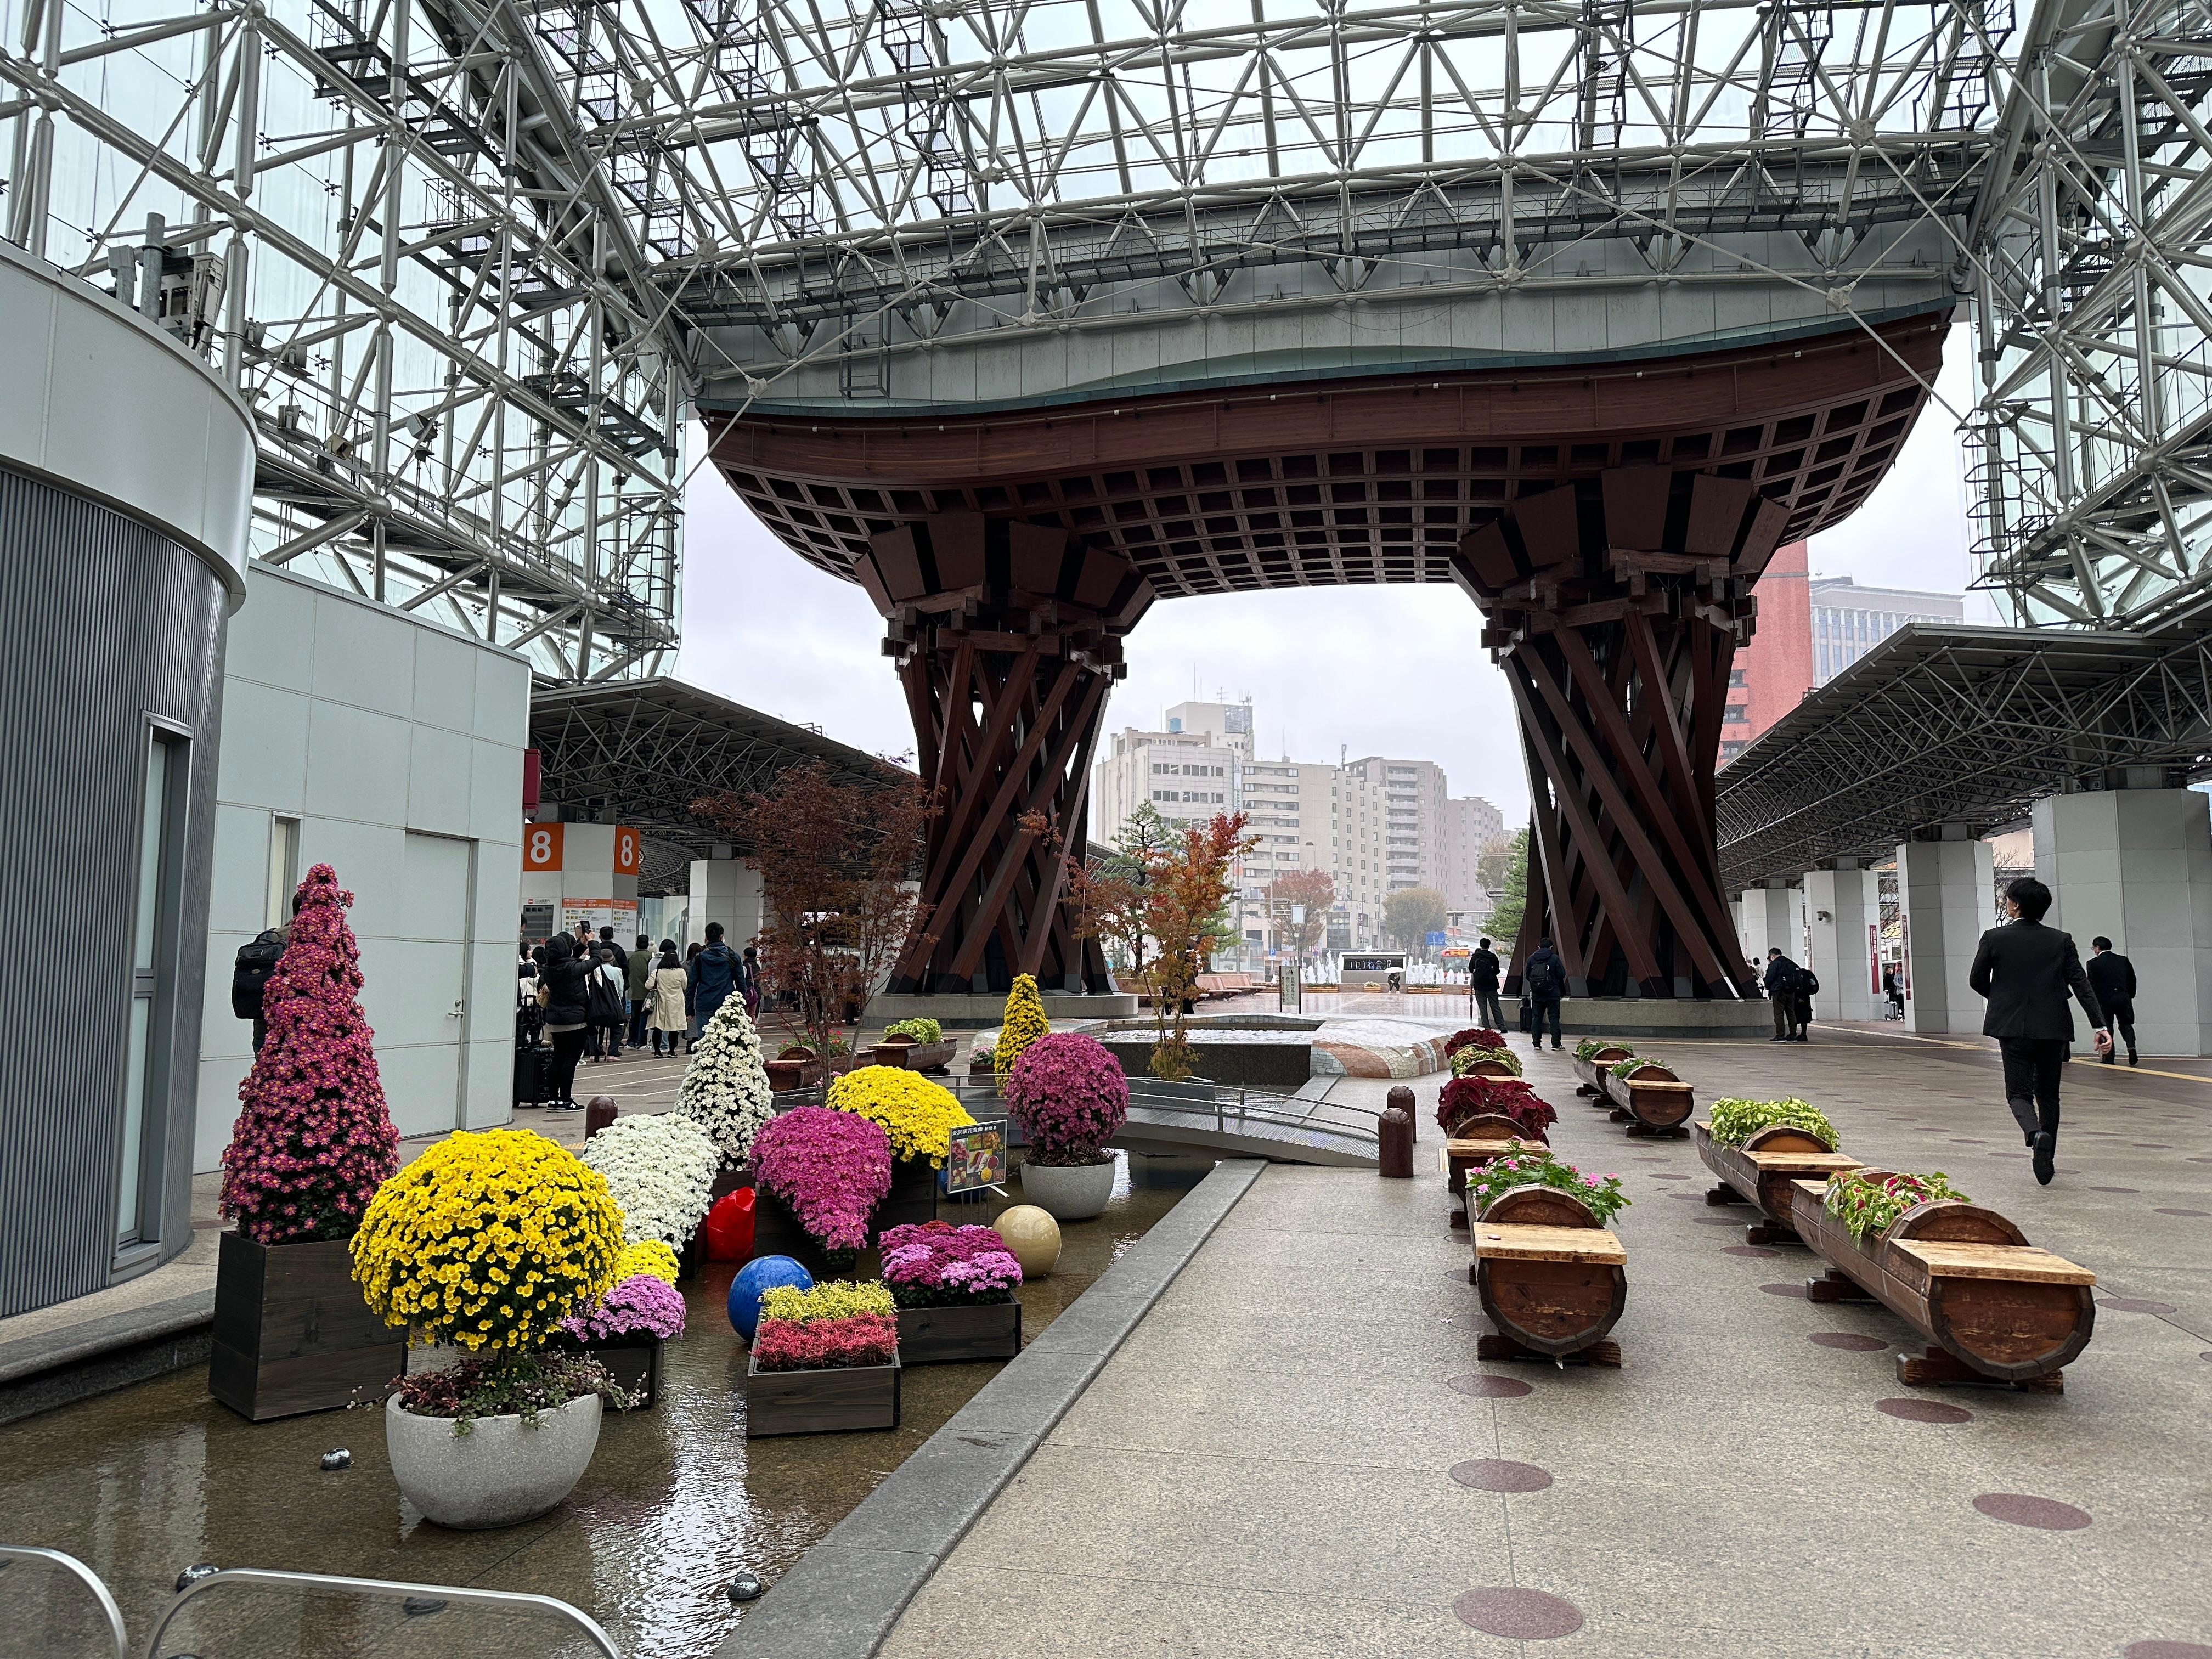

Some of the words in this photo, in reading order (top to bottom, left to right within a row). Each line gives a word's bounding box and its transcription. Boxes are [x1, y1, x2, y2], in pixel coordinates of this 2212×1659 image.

[530, 830, 551, 864] 8
[620, 834, 633, 867] 8
[952, 1127, 983, 1136] 金沢駅花装飾
